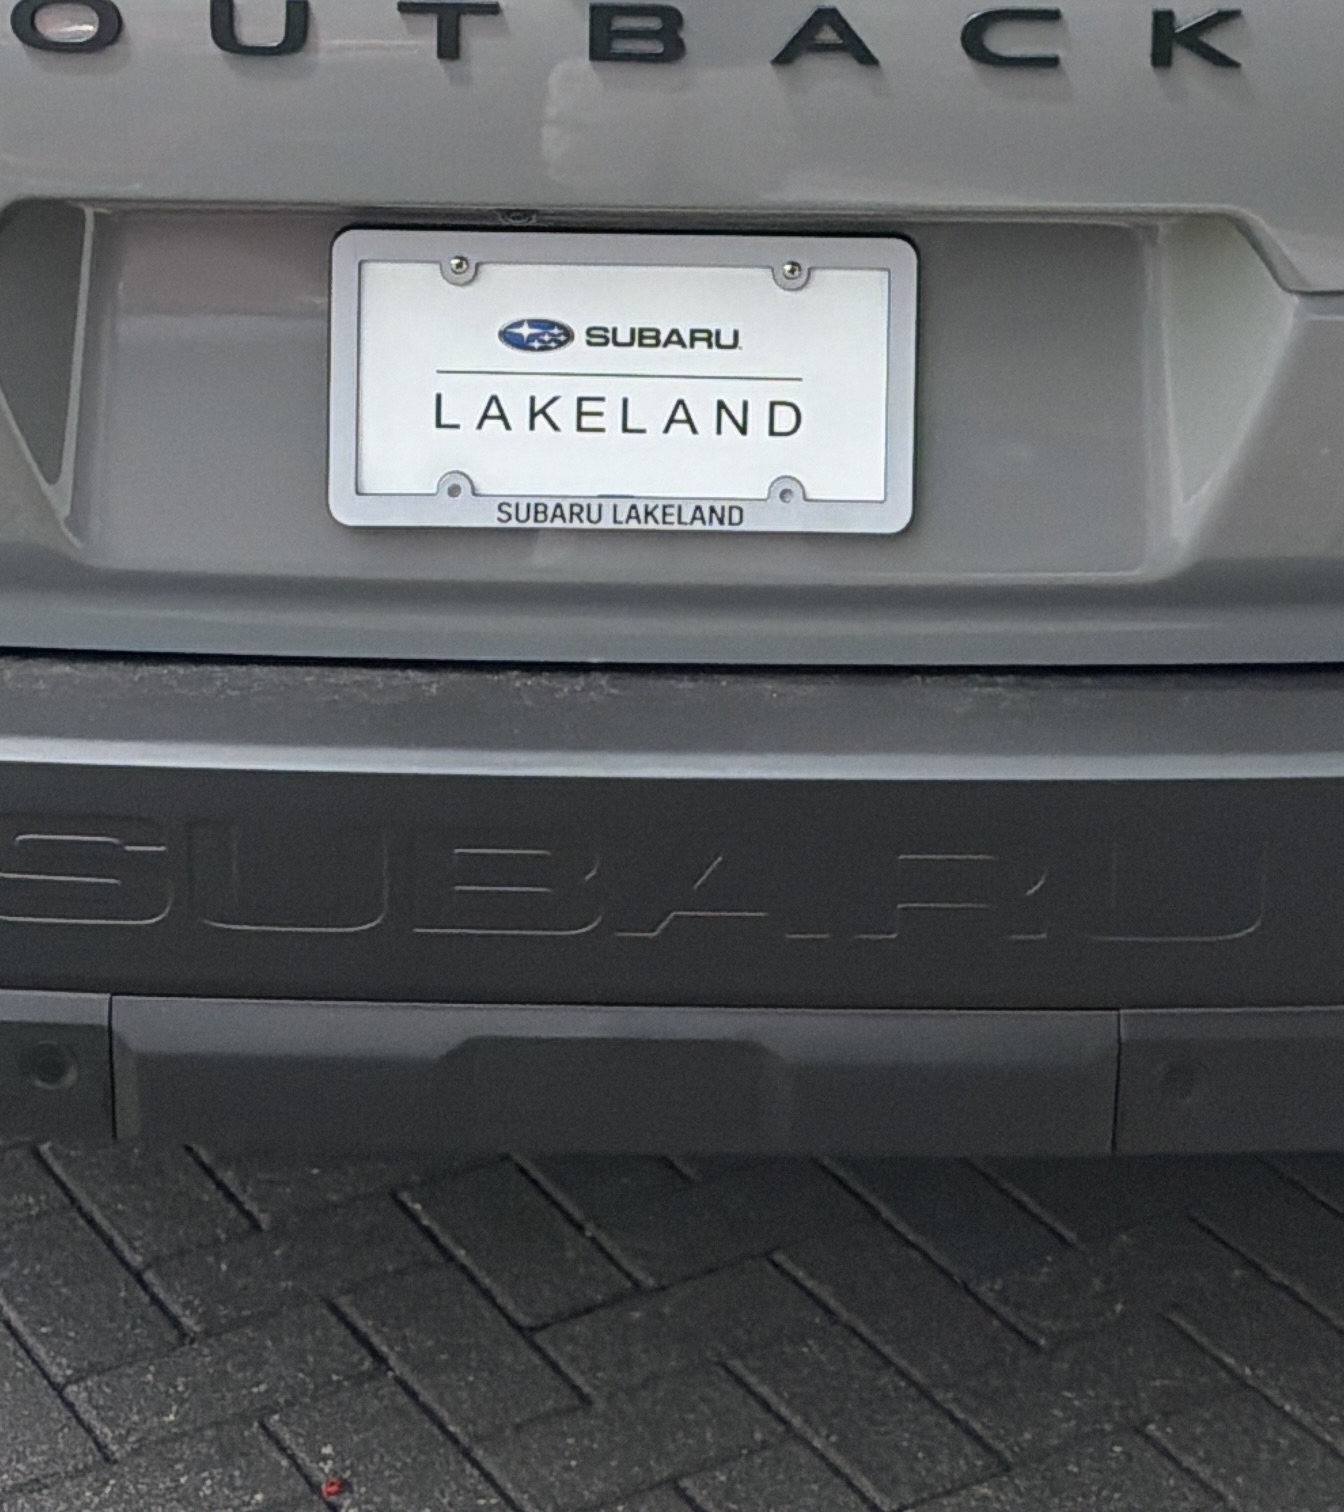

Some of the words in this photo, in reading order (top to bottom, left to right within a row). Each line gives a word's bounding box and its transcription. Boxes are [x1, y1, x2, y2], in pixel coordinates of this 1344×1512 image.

[585, 326, 740, 350] SUBARU
[434, 392, 803, 437] LAKELAND
[496, 501, 604, 524] SUBARU
[612, 504, 745, 527] LAKELAND
